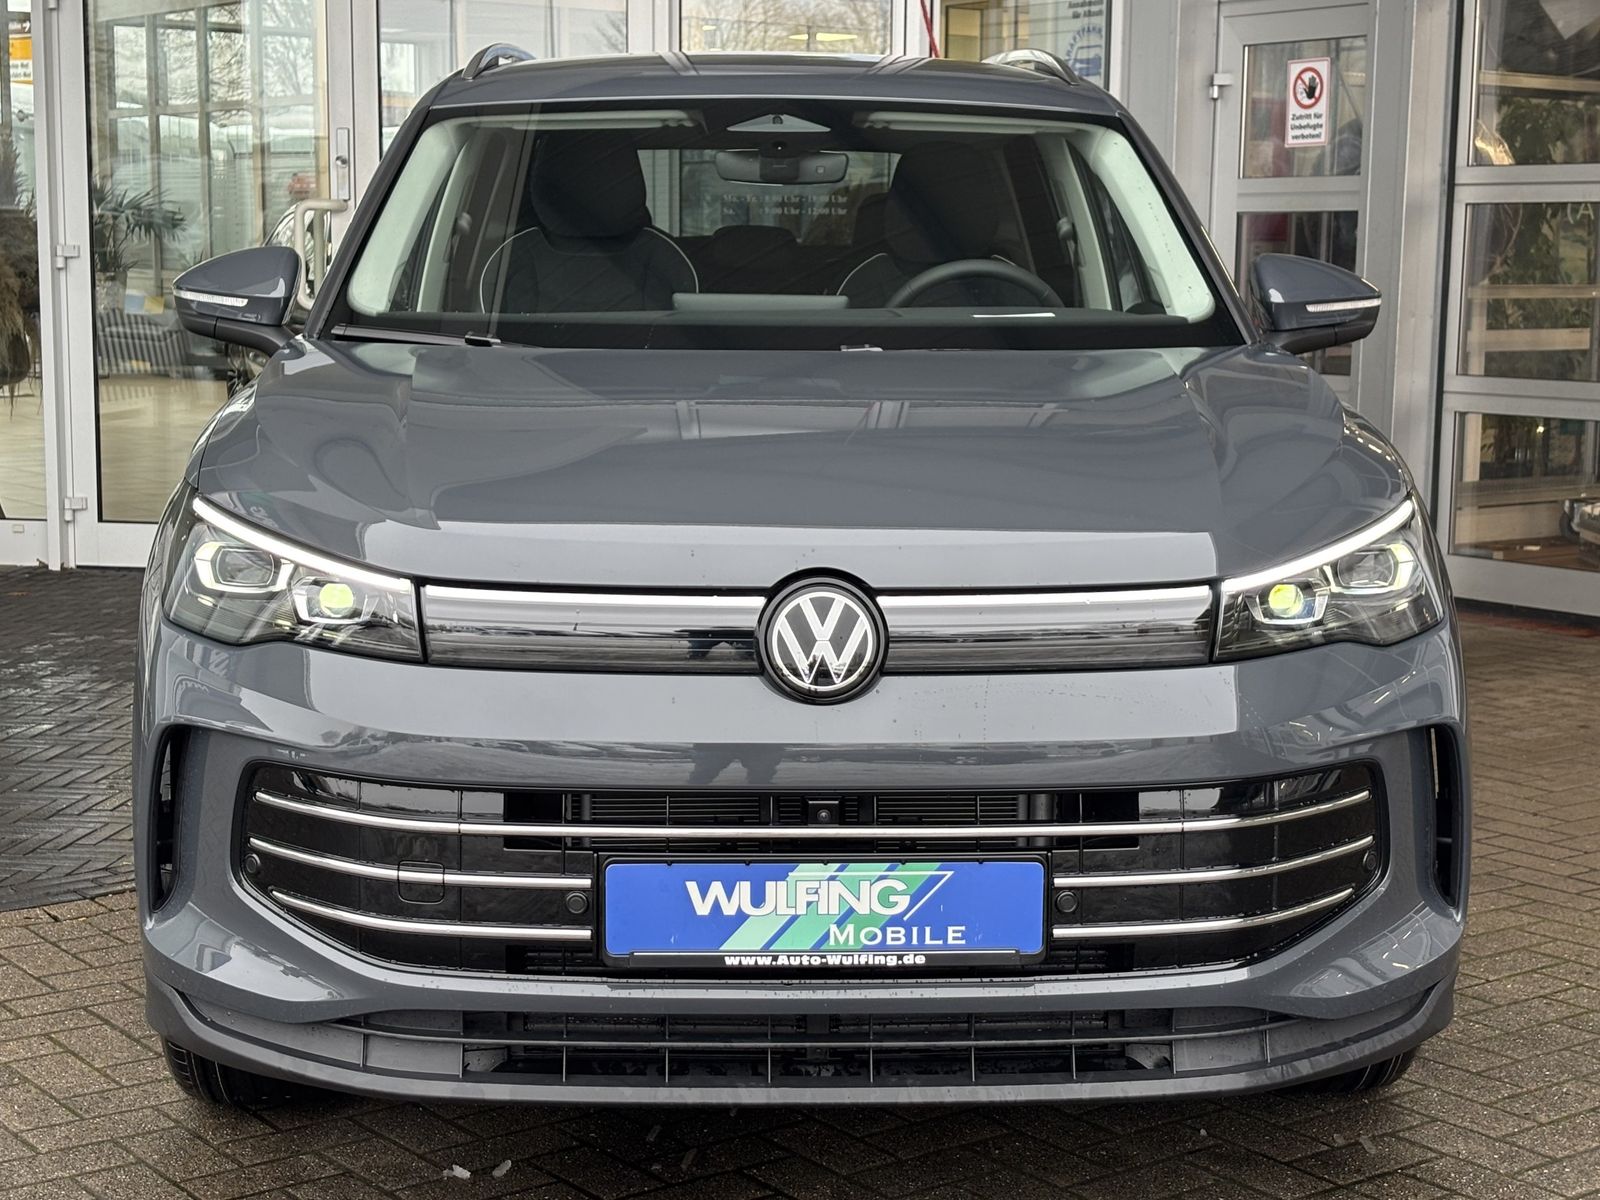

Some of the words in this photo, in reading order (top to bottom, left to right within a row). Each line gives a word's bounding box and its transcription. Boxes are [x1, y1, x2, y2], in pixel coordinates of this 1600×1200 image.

[1291, 113, 1312, 121] Zutritt
[1290, 123, 1323, 131] Unbefugte
[1291, 131, 1322, 140] verboten!
[831, 194, 848, 203] Uhr
[831, 207, 848, 215] Uhr
[776, 594, 868, 686] VW
[685, 879, 912, 917] WULFING
[724, 953, 927, 967] www.Auto-Wulfing.de
